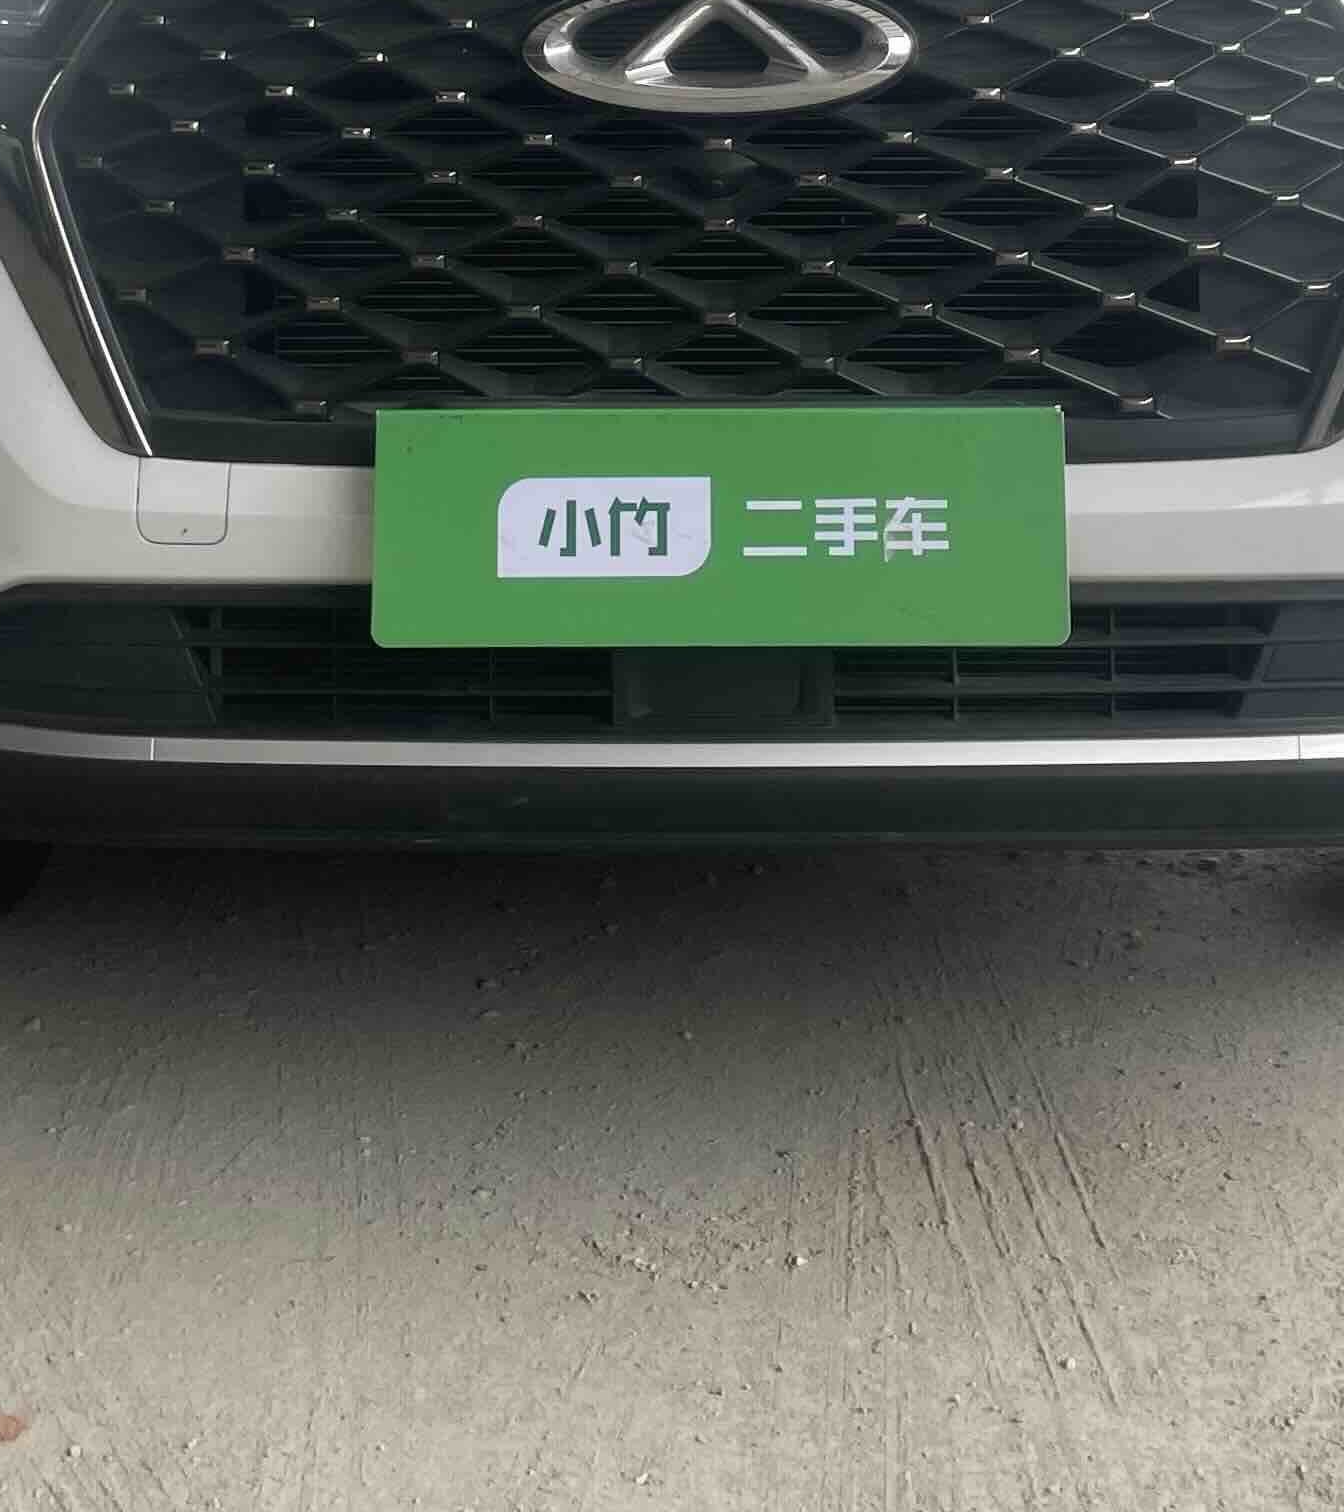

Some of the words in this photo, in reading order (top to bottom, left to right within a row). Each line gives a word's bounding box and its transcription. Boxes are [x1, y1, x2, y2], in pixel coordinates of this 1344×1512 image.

[538, 496, 671, 557] 小竹
[743, 496, 949, 561] 二手车
